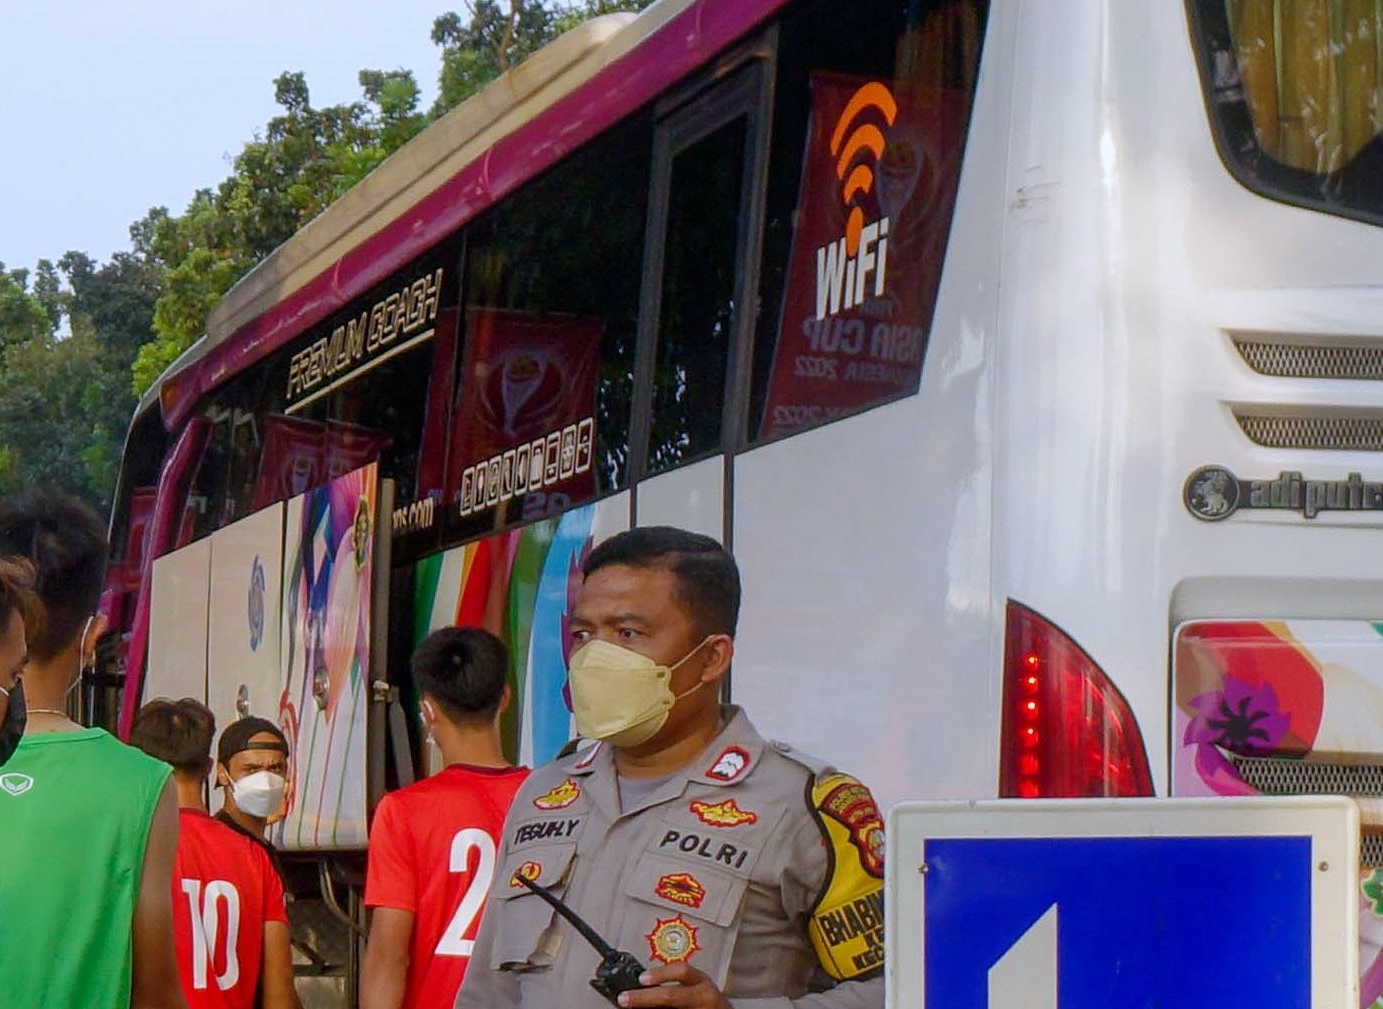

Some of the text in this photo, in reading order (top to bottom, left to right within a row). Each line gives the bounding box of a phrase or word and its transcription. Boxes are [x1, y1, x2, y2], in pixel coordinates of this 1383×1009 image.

[366, 267, 444, 352] COACH
[816, 216, 889, 321] WiFi
[435, 827, 496, 957] 2
[660, 830, 748, 868] POLRI
[181, 878, 240, 992] 10
